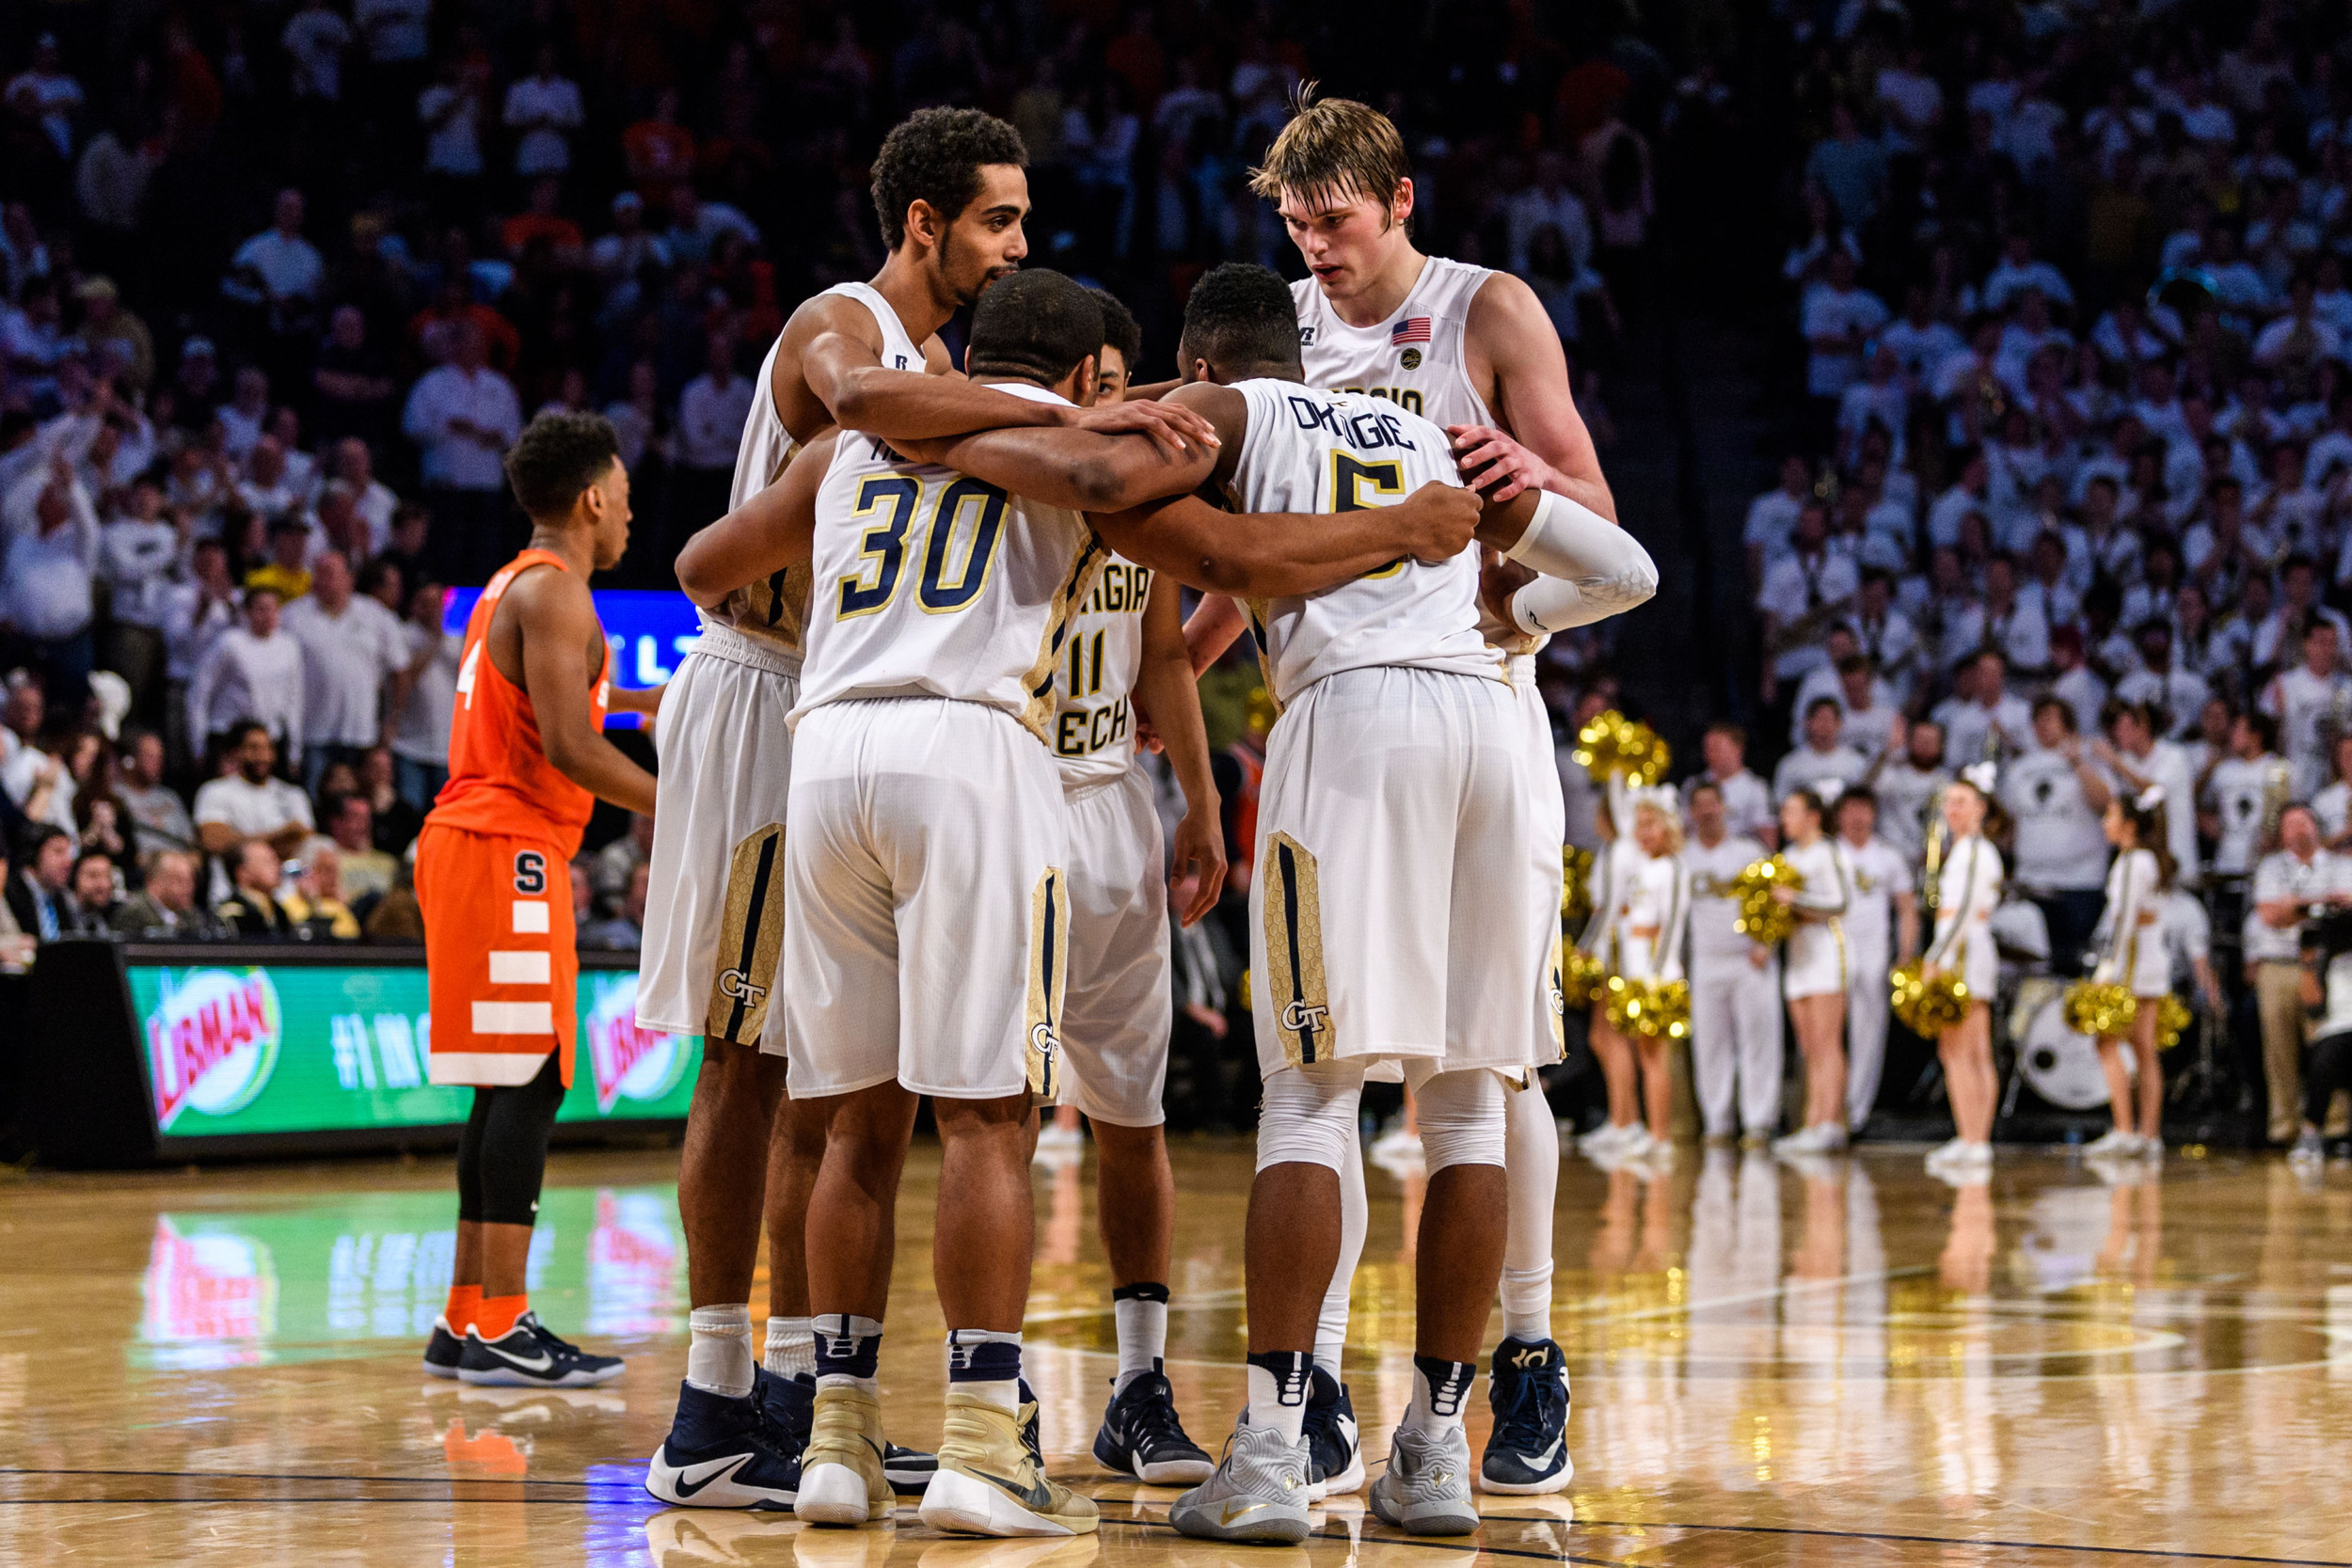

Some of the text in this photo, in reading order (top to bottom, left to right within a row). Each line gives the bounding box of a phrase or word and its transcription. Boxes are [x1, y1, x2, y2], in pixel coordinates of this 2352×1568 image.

[835, 472, 1011, 624] 30
[1068, 628, 1105, 701] 11
[1056, 693, 1129, 757] ECH
[514, 849, 548, 896] S
[718, 967, 766, 1008] GT
[1281, 997, 1328, 1034] GT
